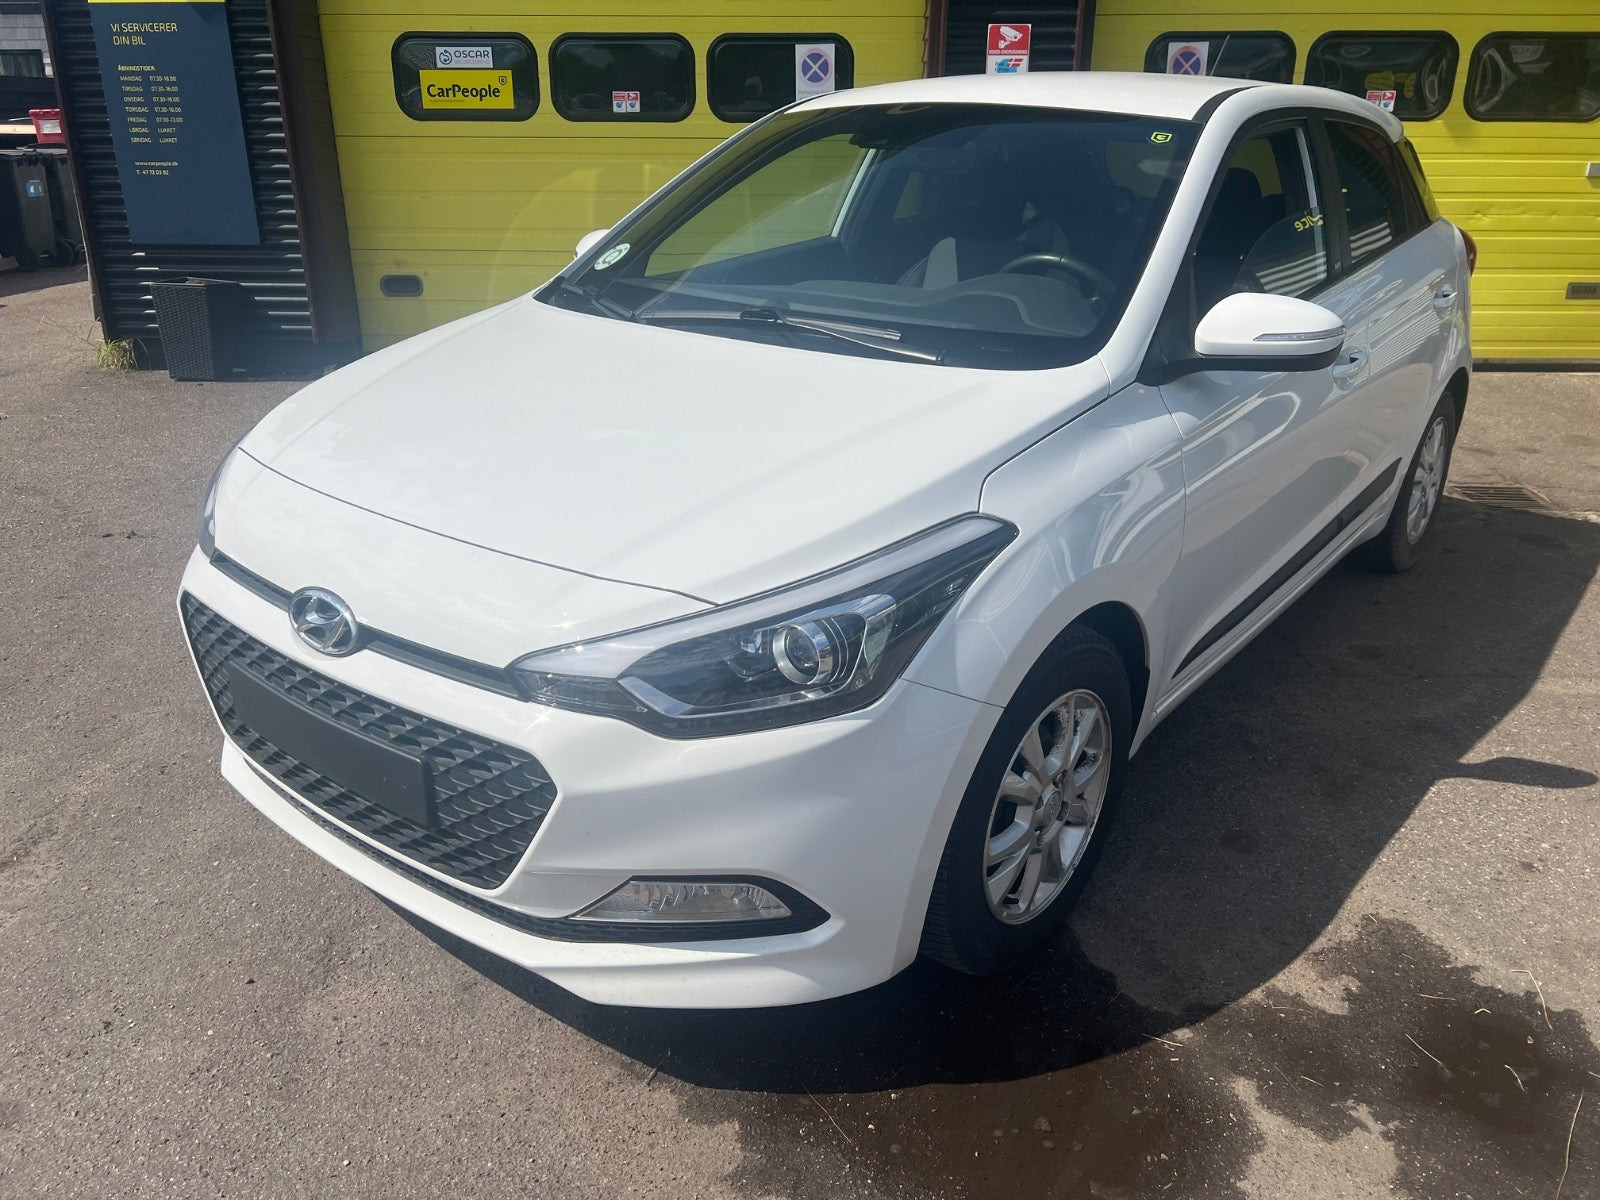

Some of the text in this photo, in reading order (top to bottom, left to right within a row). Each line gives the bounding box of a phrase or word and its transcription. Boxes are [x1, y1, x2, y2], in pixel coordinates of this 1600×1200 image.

[110, 22, 178, 32] VI SERVICERER
[113, 36, 146, 46] DIN BIL
[454, 50, 490, 58] OSCAR
[426, 84, 500, 102] CarPeople
